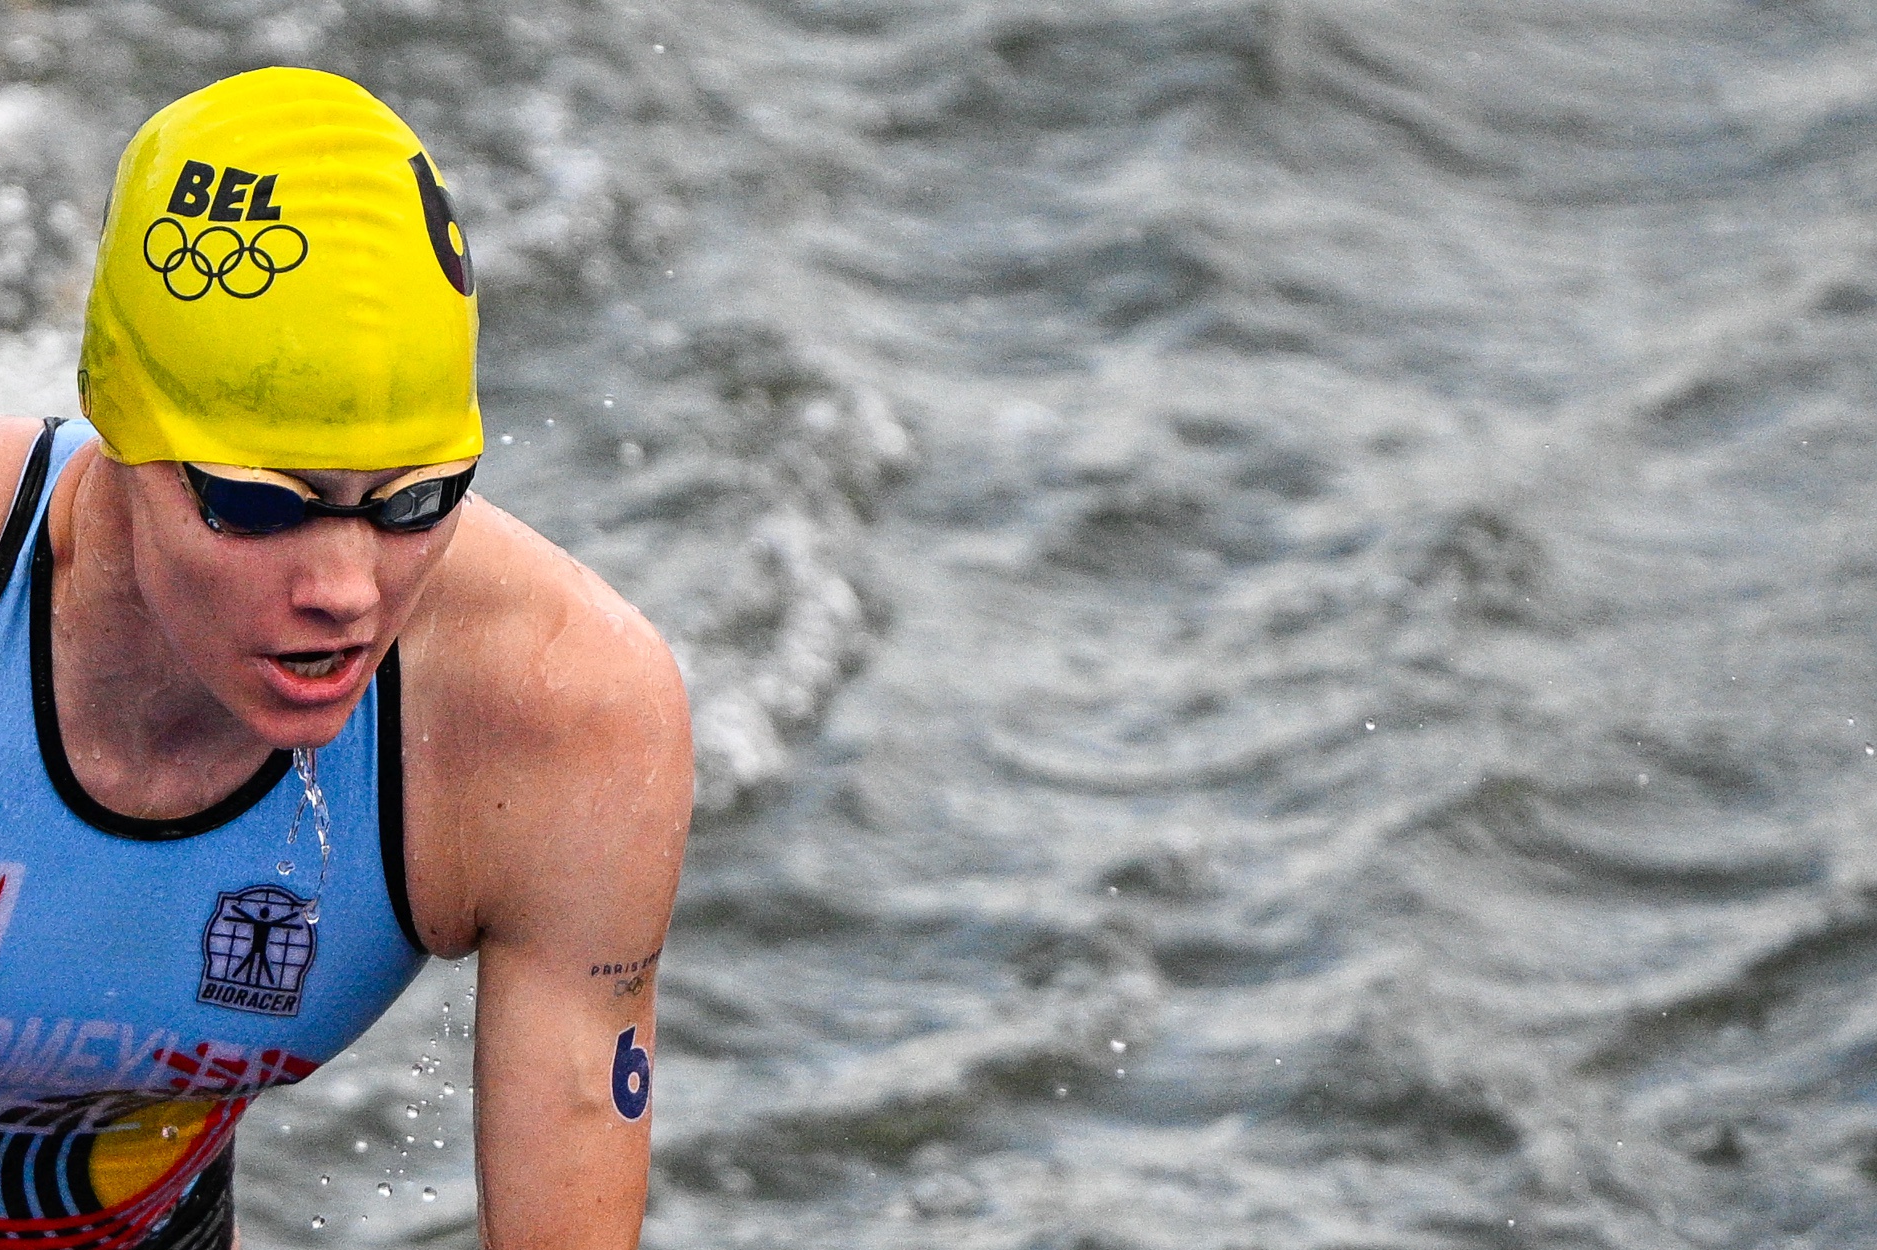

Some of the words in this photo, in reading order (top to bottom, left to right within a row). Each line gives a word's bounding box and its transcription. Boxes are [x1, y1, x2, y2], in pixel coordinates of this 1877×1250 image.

[167, 159, 282, 222] BEL
[591, 961, 638, 976] PARIS
[201, 982, 299, 1012] BIORACER
[609, 1024, 652, 1122] 6
